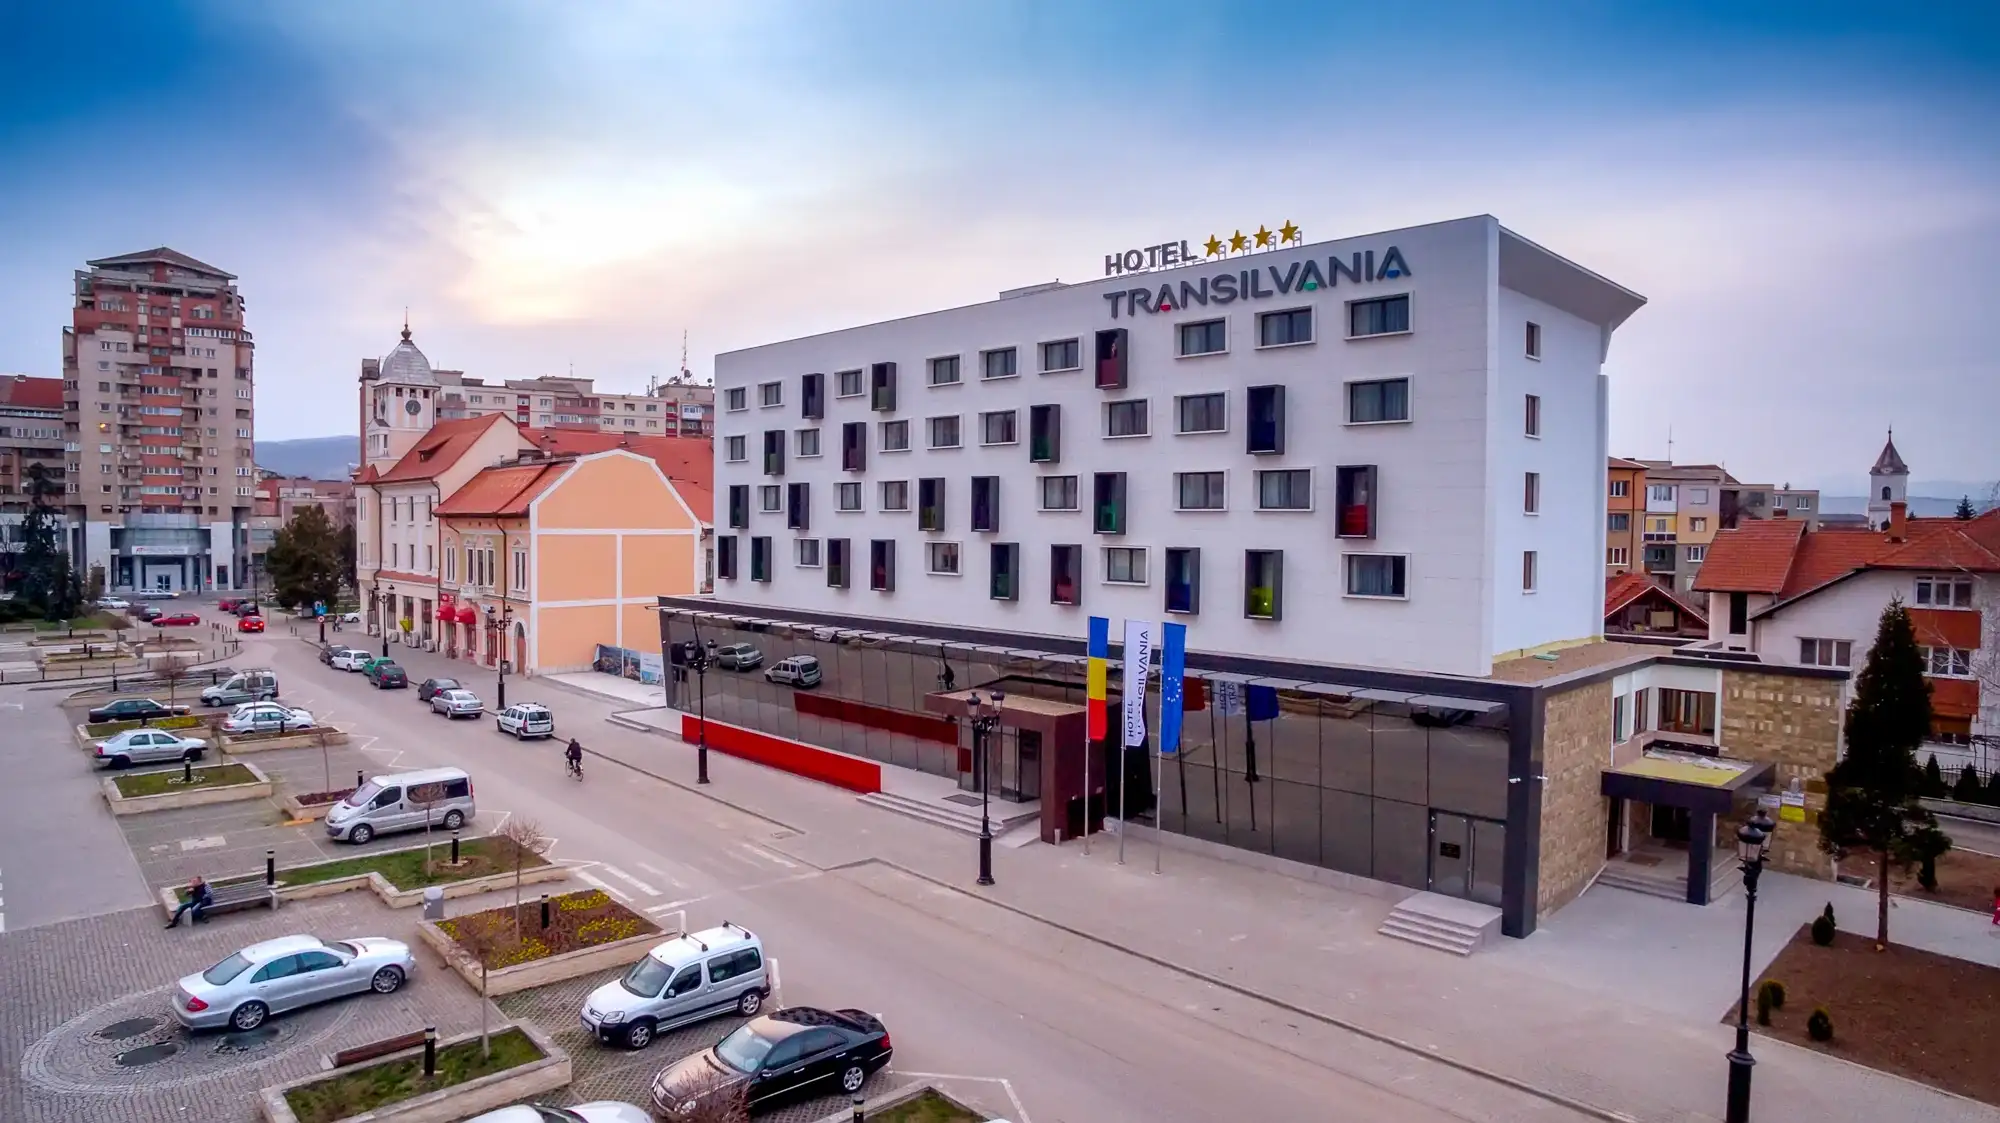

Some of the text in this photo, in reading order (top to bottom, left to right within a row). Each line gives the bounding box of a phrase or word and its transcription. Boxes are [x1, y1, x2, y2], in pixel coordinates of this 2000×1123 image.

[1103, 246, 1412, 319] TRANSILVANIA
[1105, 240, 1198, 276] HOTEL
[1137, 630, 1149, 735] TSILVANIA
